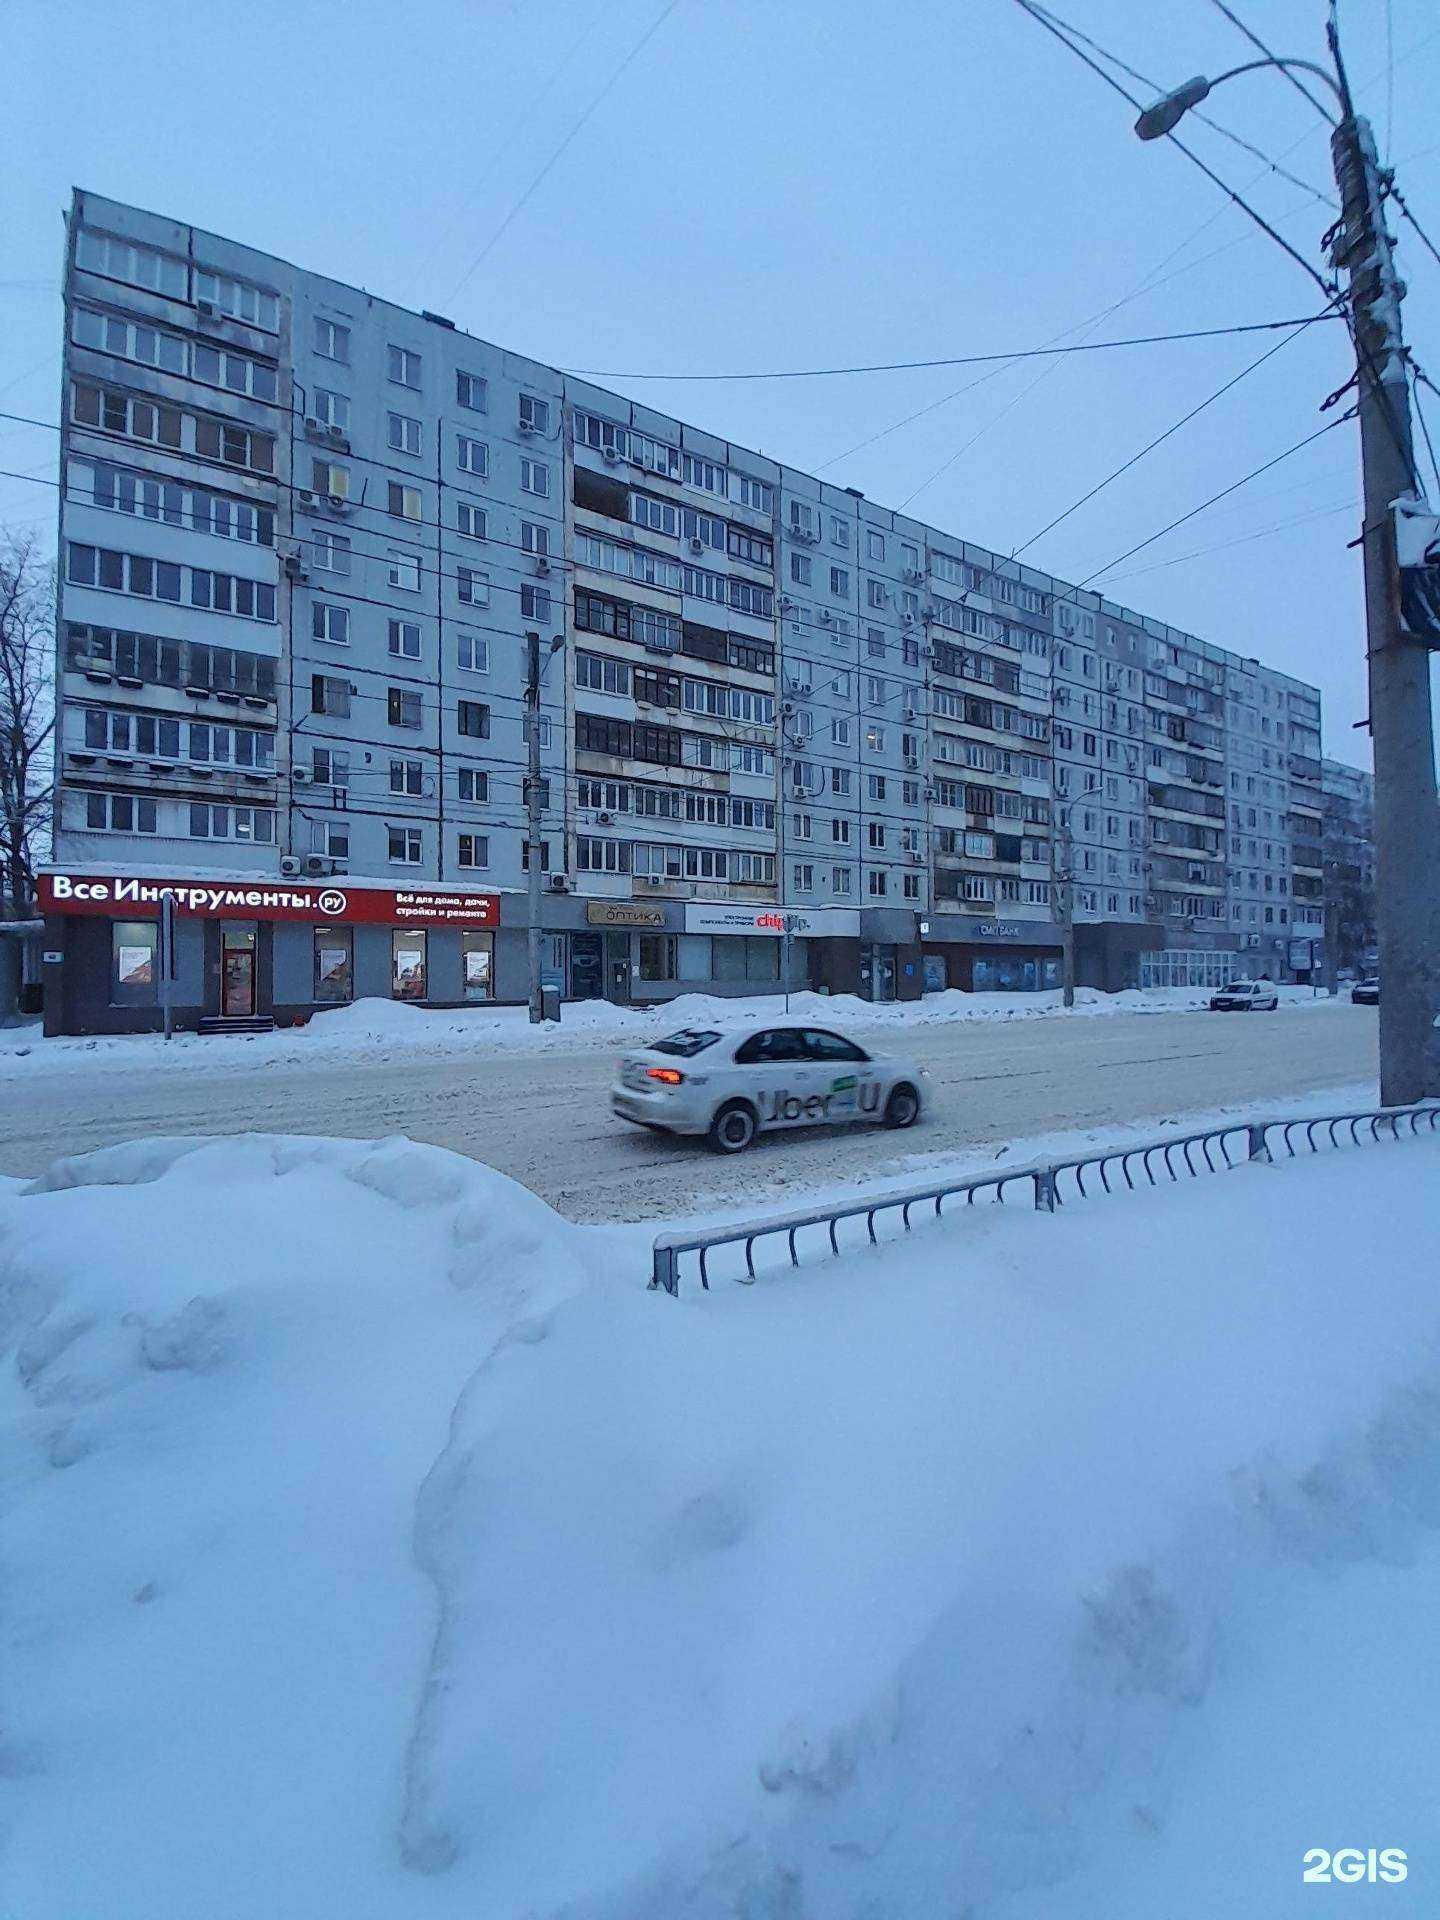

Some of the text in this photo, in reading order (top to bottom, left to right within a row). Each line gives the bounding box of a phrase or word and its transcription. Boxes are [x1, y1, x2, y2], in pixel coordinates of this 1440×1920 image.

[53, 876, 108, 900] Все
[396, 893, 414, 903] Всё
[415, 896, 433, 904] для
[434, 897, 462, 906] дома,
[396, 907, 437, 917] стройки
[446, 910, 487, 919] ремонта
